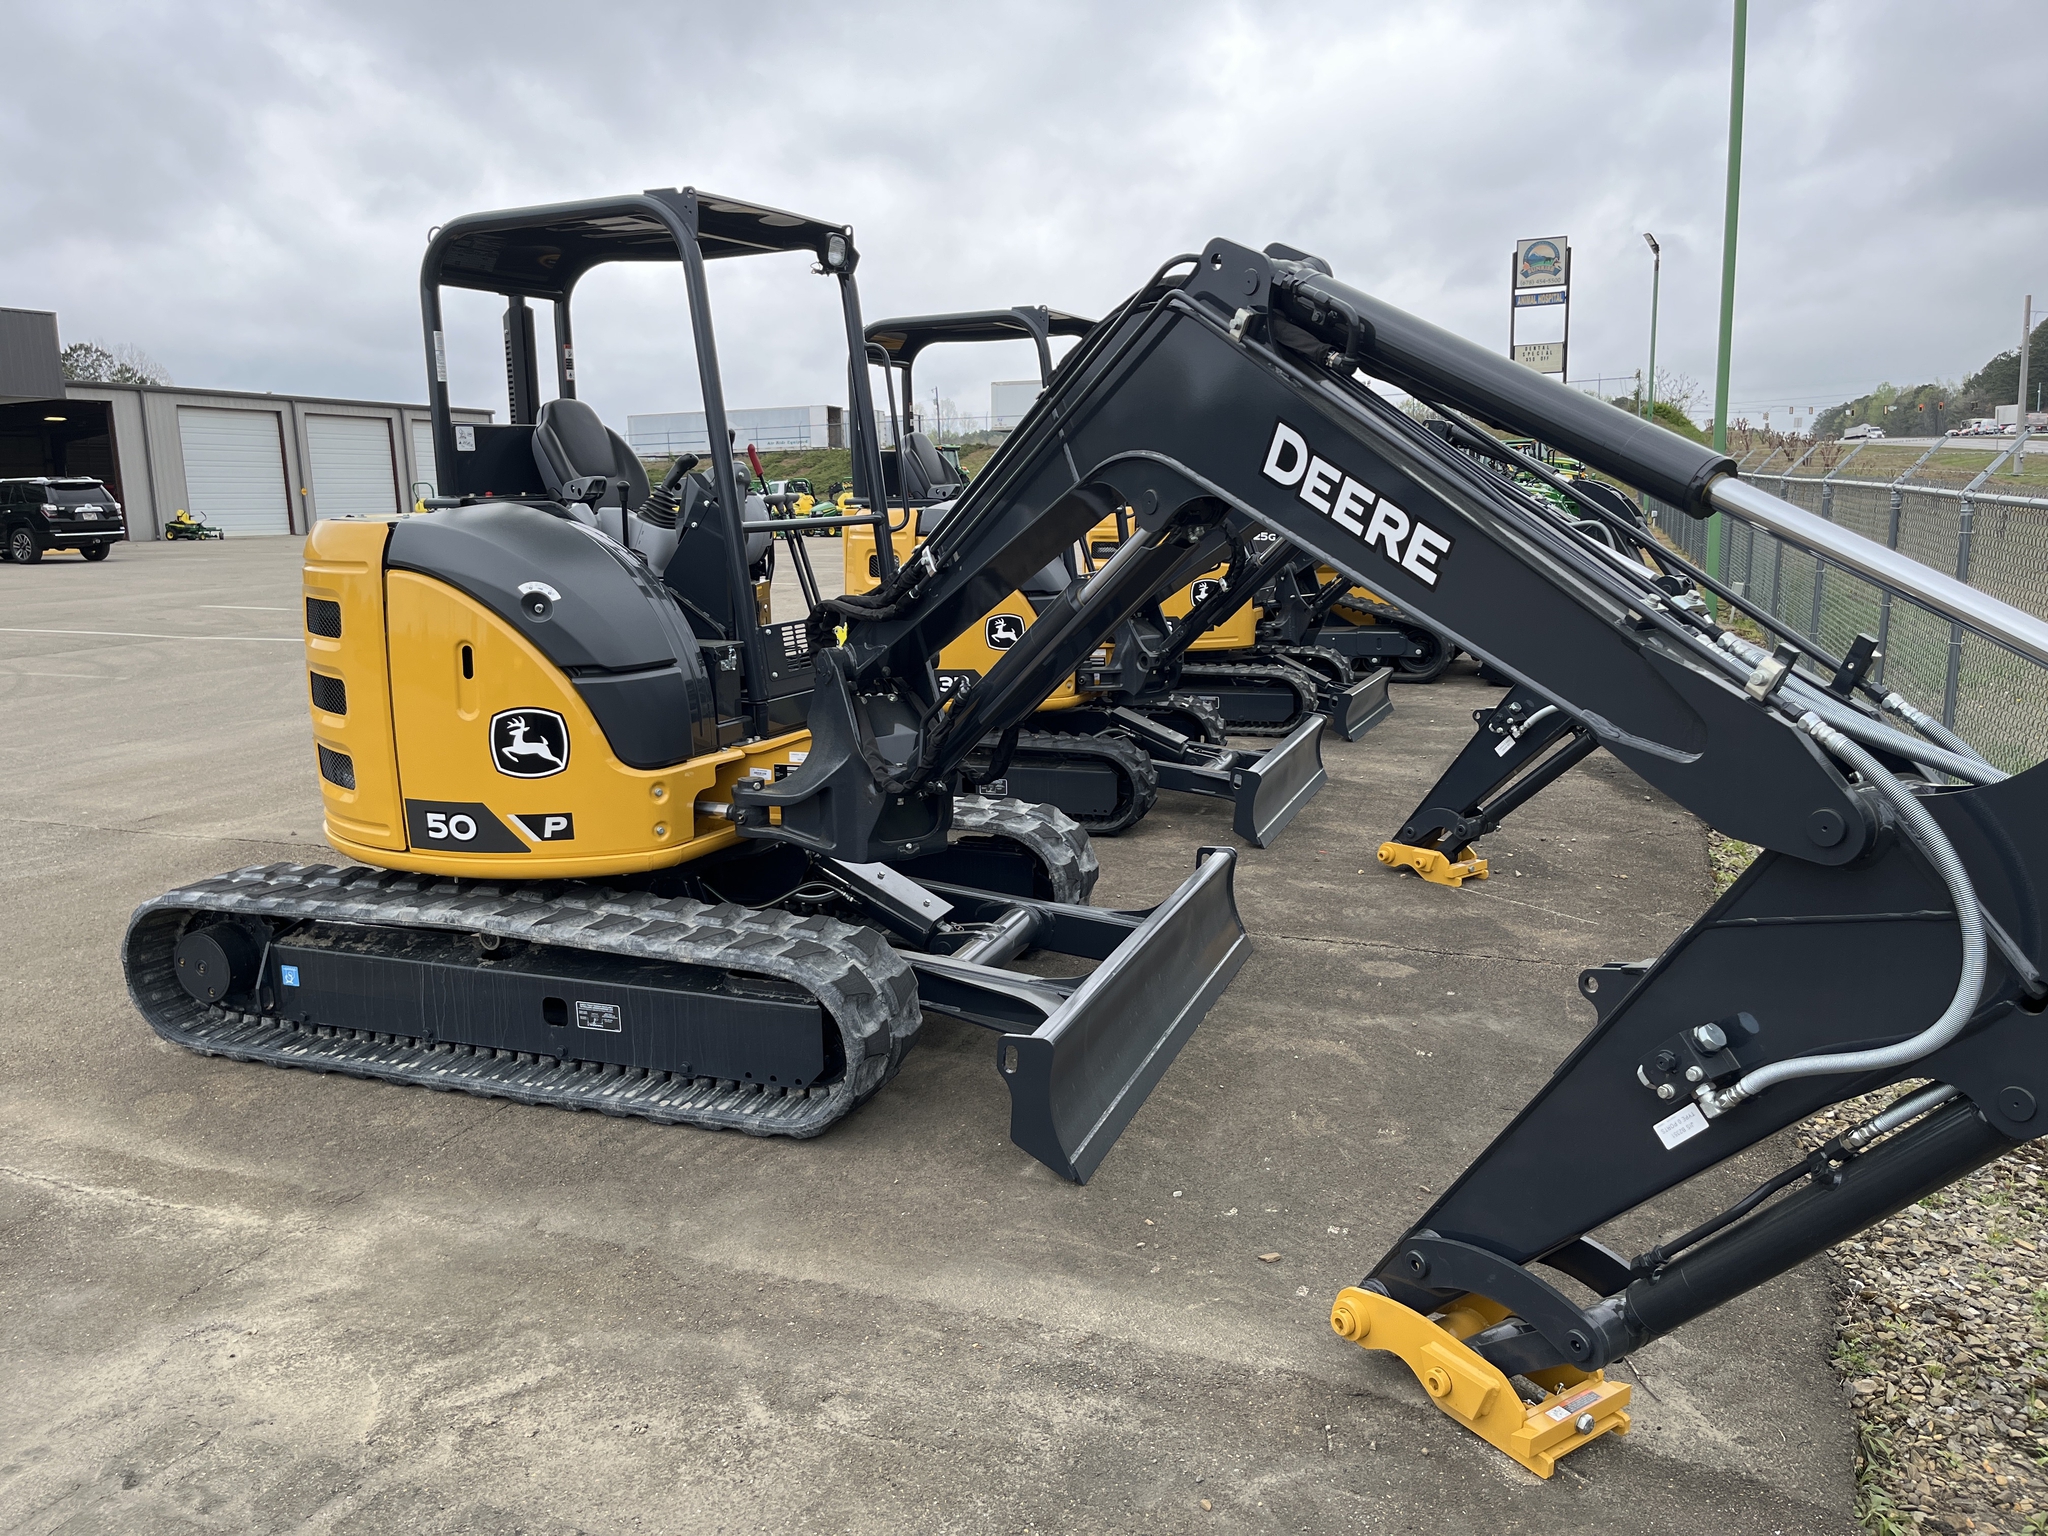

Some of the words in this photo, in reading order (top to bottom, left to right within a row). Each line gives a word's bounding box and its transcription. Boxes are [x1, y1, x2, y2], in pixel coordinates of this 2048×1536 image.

[1517, 295, 1537, 305] ANIMAL
[1538, 292, 1563, 304] HOSPITAL
[1263, 422, 1451, 586] DEERE
[1252, 531, 1276, 542] 25G
[426, 812, 477, 841] 50
[543, 816, 568, 838] P
[1681, 1111, 1695, 1122] TYPE
[1661, 1121, 1678, 1134] PORTS
